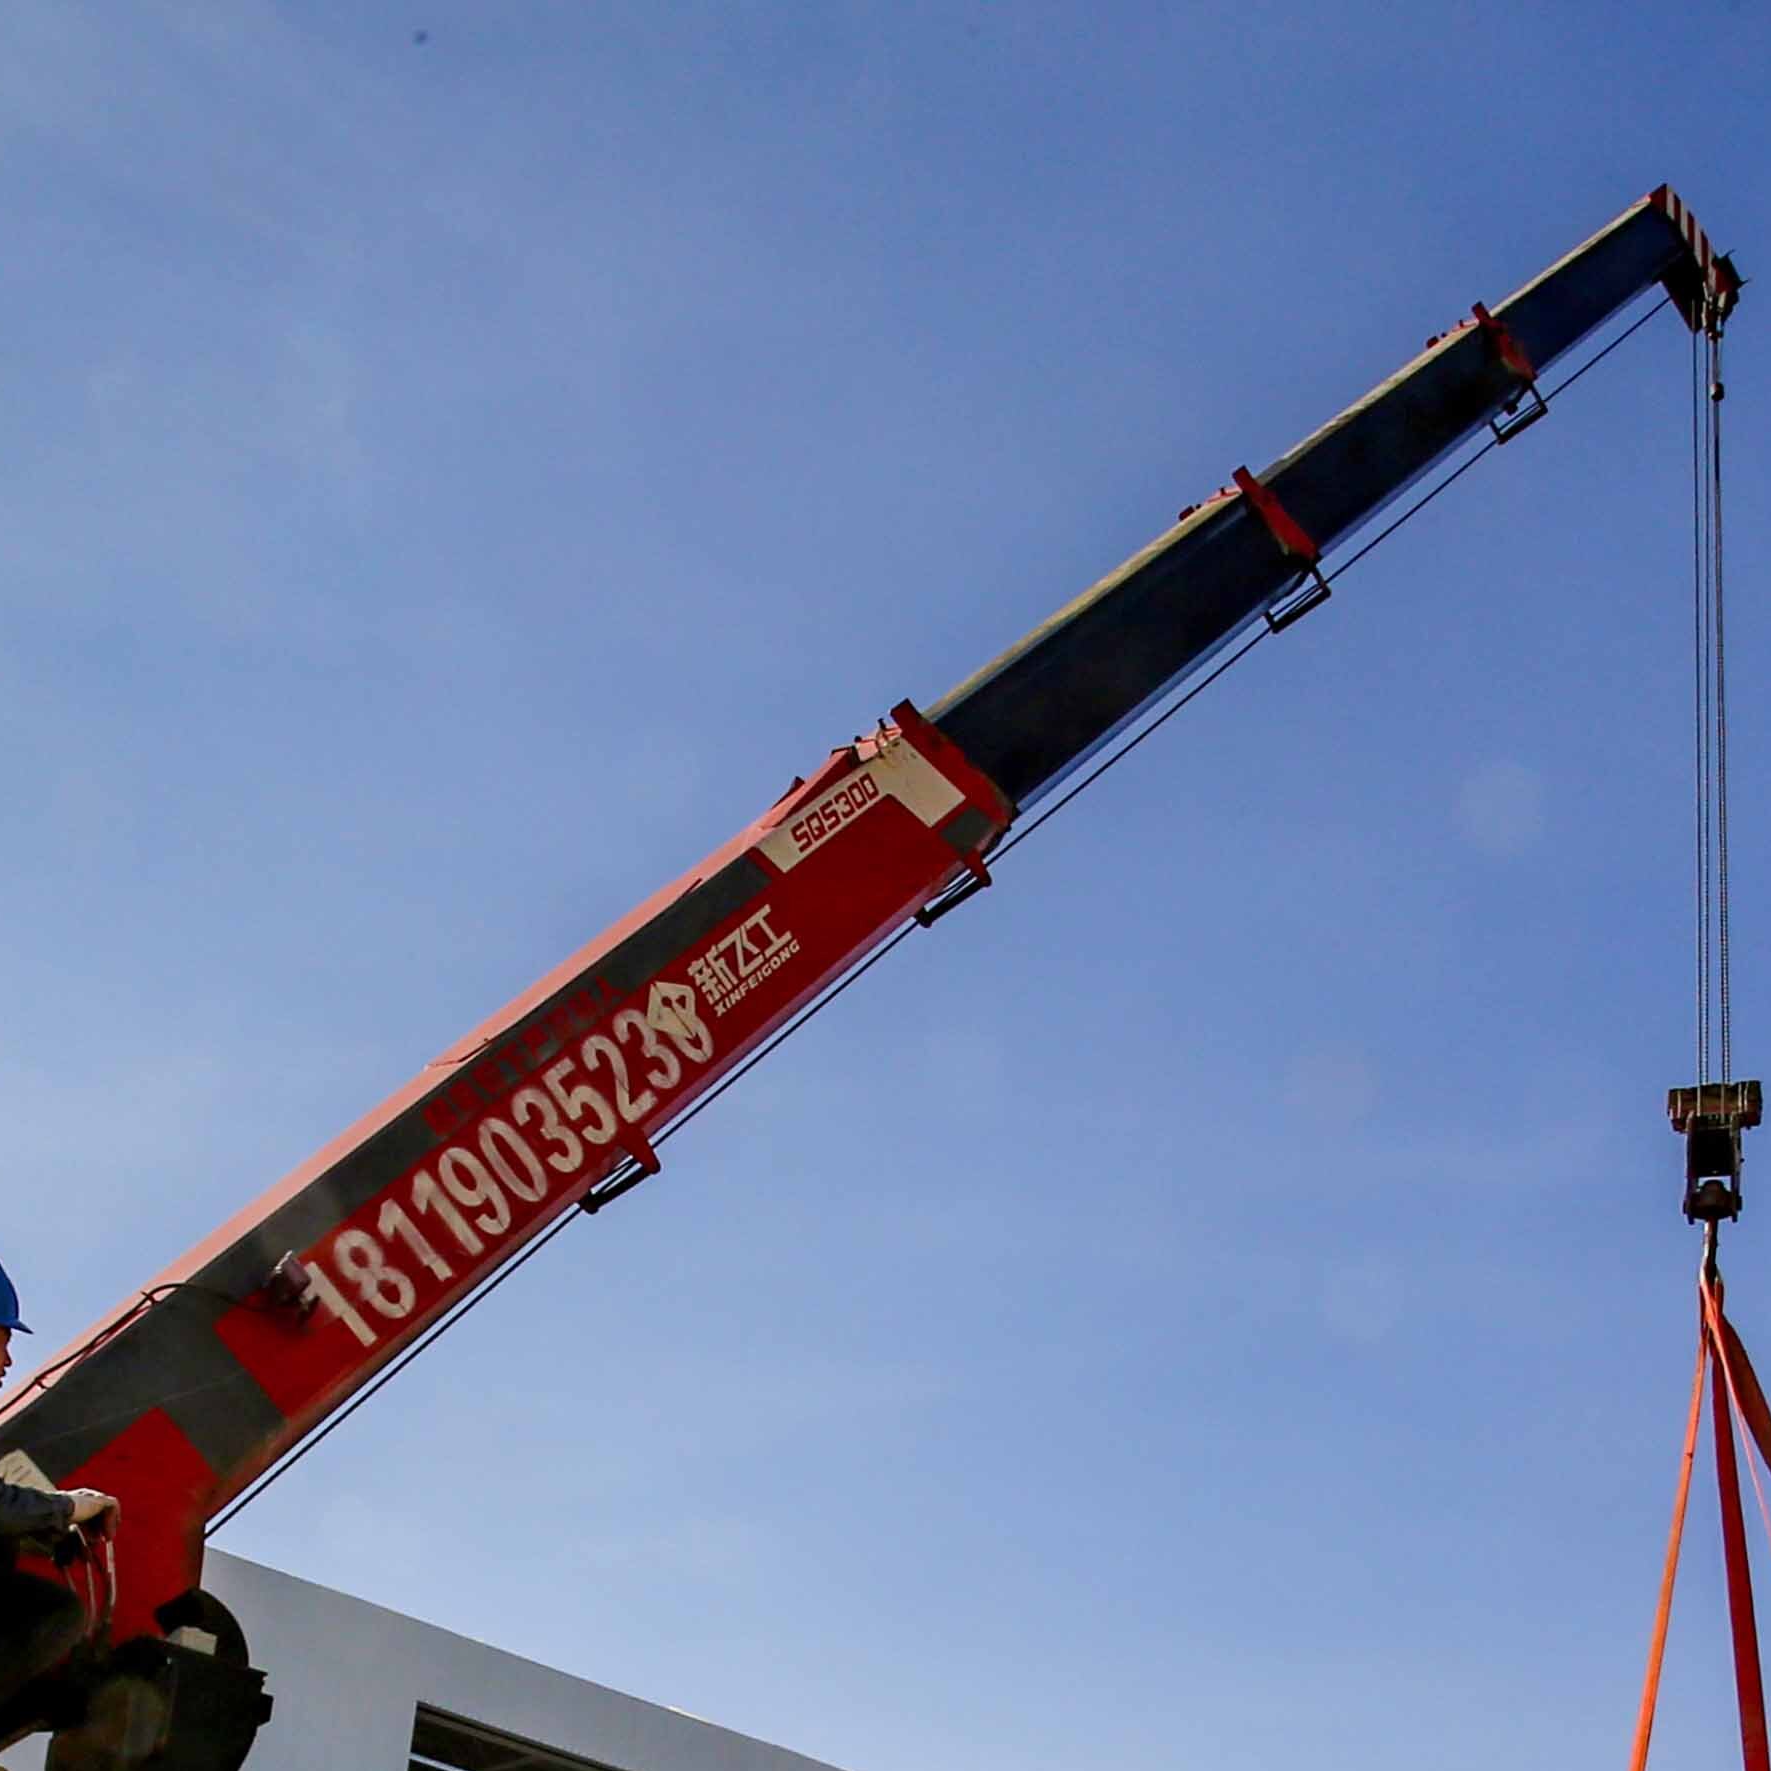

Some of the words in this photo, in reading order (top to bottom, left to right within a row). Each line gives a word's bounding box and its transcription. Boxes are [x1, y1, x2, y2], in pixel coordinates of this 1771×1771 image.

[790, 771, 880, 854] SQS300
[687, 903, 793, 1006] 新飞工
[713, 938, 801, 1018] XINFEIGONG
